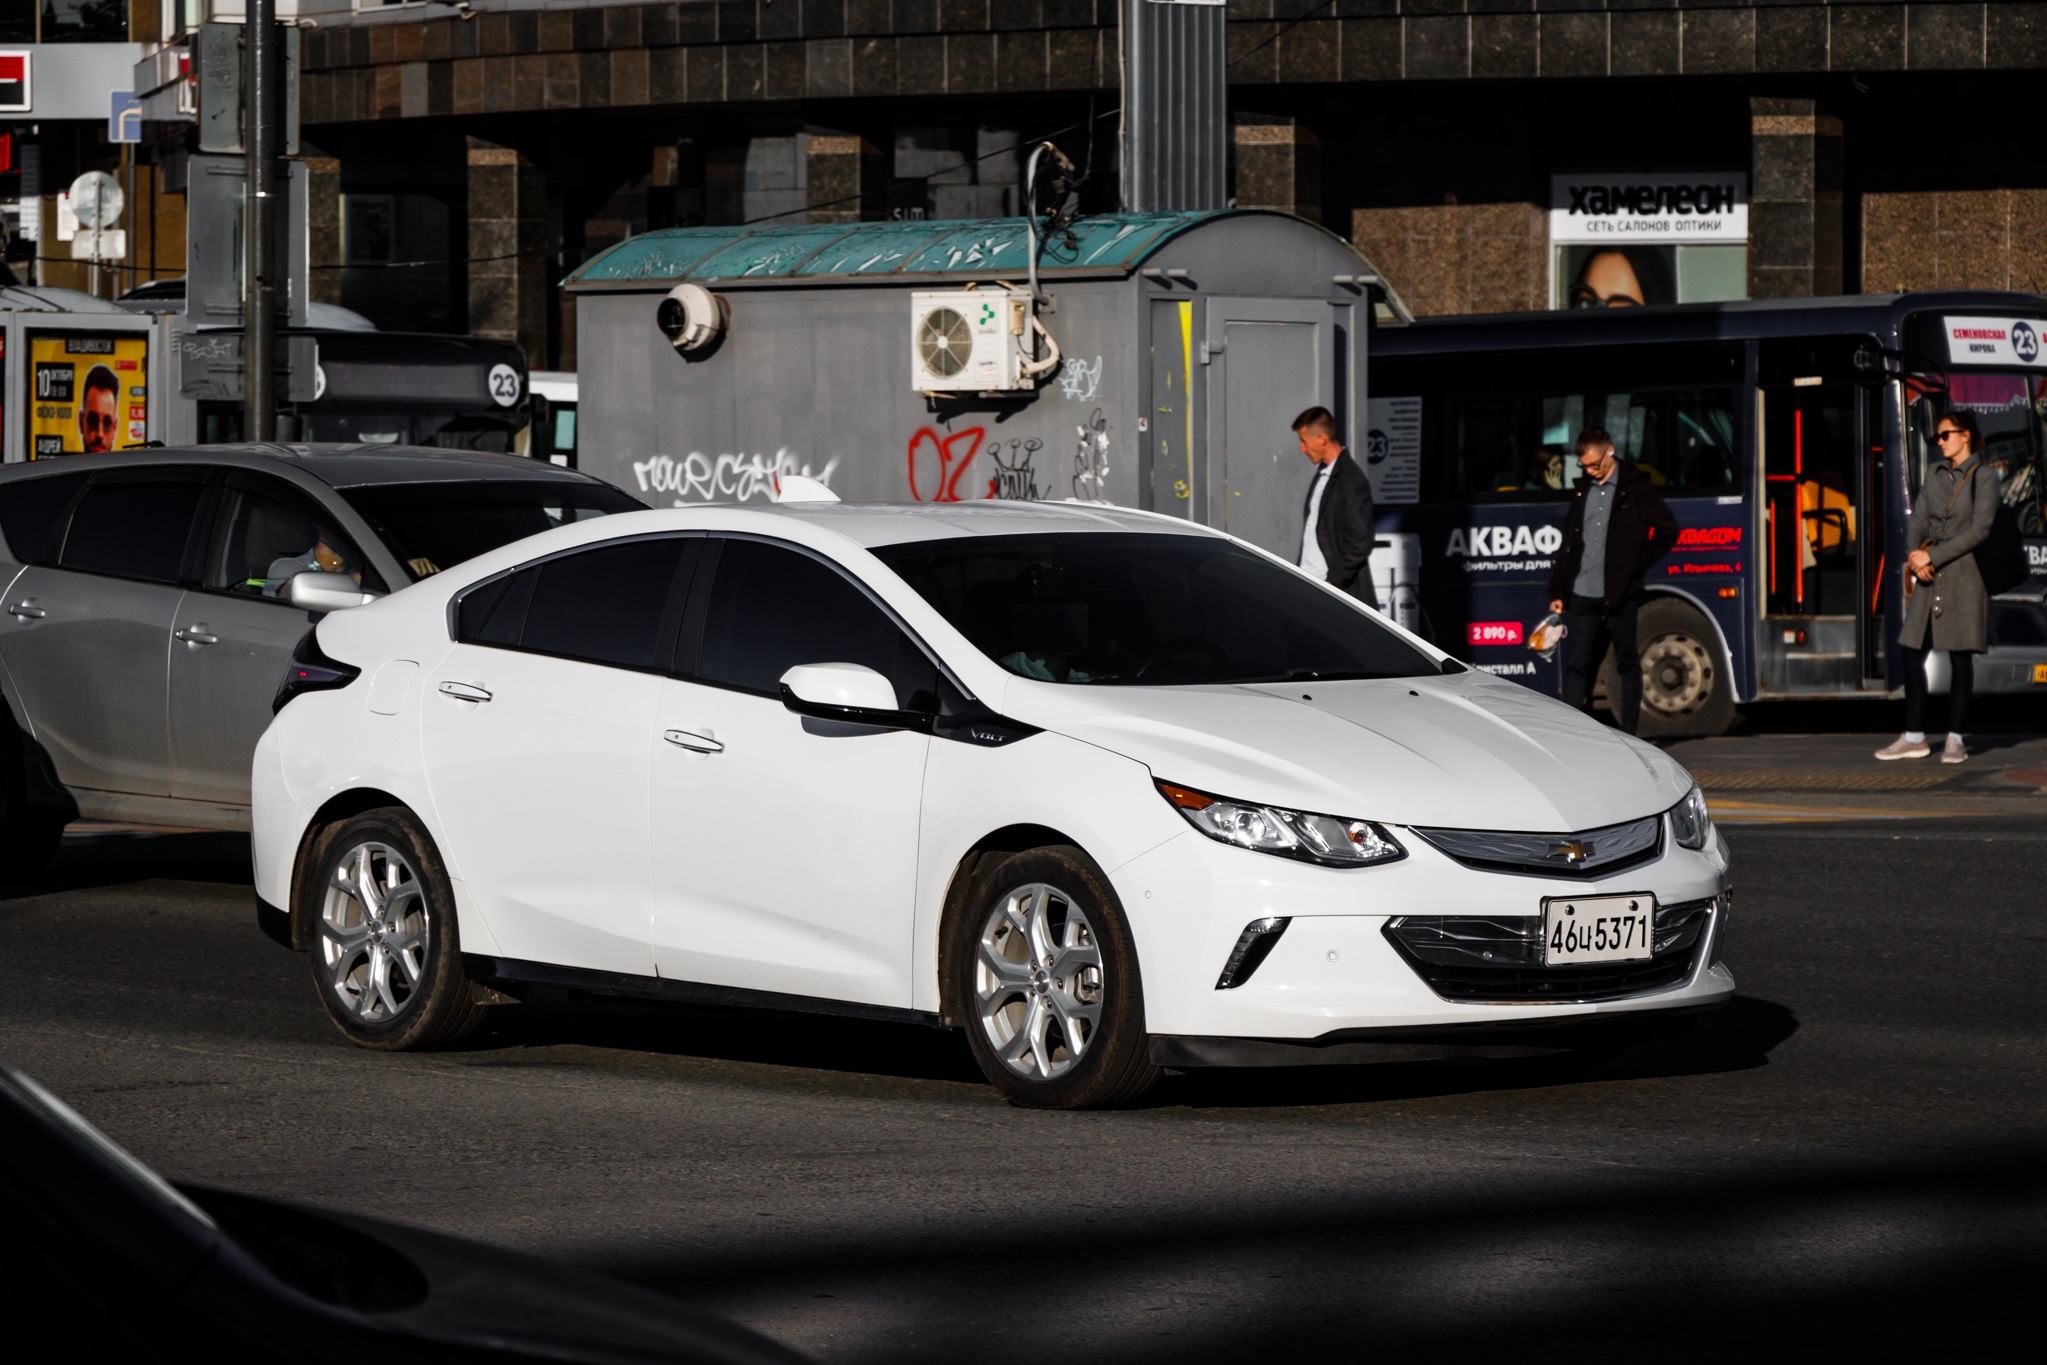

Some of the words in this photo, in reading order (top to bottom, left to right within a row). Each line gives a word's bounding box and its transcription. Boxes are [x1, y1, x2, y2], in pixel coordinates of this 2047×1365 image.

[1569, 185, 1734, 215] хамелеон
[1587, 220, 1614, 232] СЕТЬ
[1618, 220, 1670, 232] САЛОНОВ
[1676, 220, 1722, 231] ОПТИКИ
[1953, 328, 2007, 340] СЕМЕНОВСКАЯ
[1969, 343, 1996, 354] КИРОВА
[2013, 329, 2037, 355] 23
[38, 369, 50, 397] 10
[493, 374, 516, 397] 23
[1463, 561, 1524, 572] фильтры
[1525, 560, 1551, 571] для
[1473, 628, 1481, 640] 2
[1484, 627, 1505, 640] 890
[1527, 661, 1536, 674] А
[971, 728, 1007, 741] VOLT
